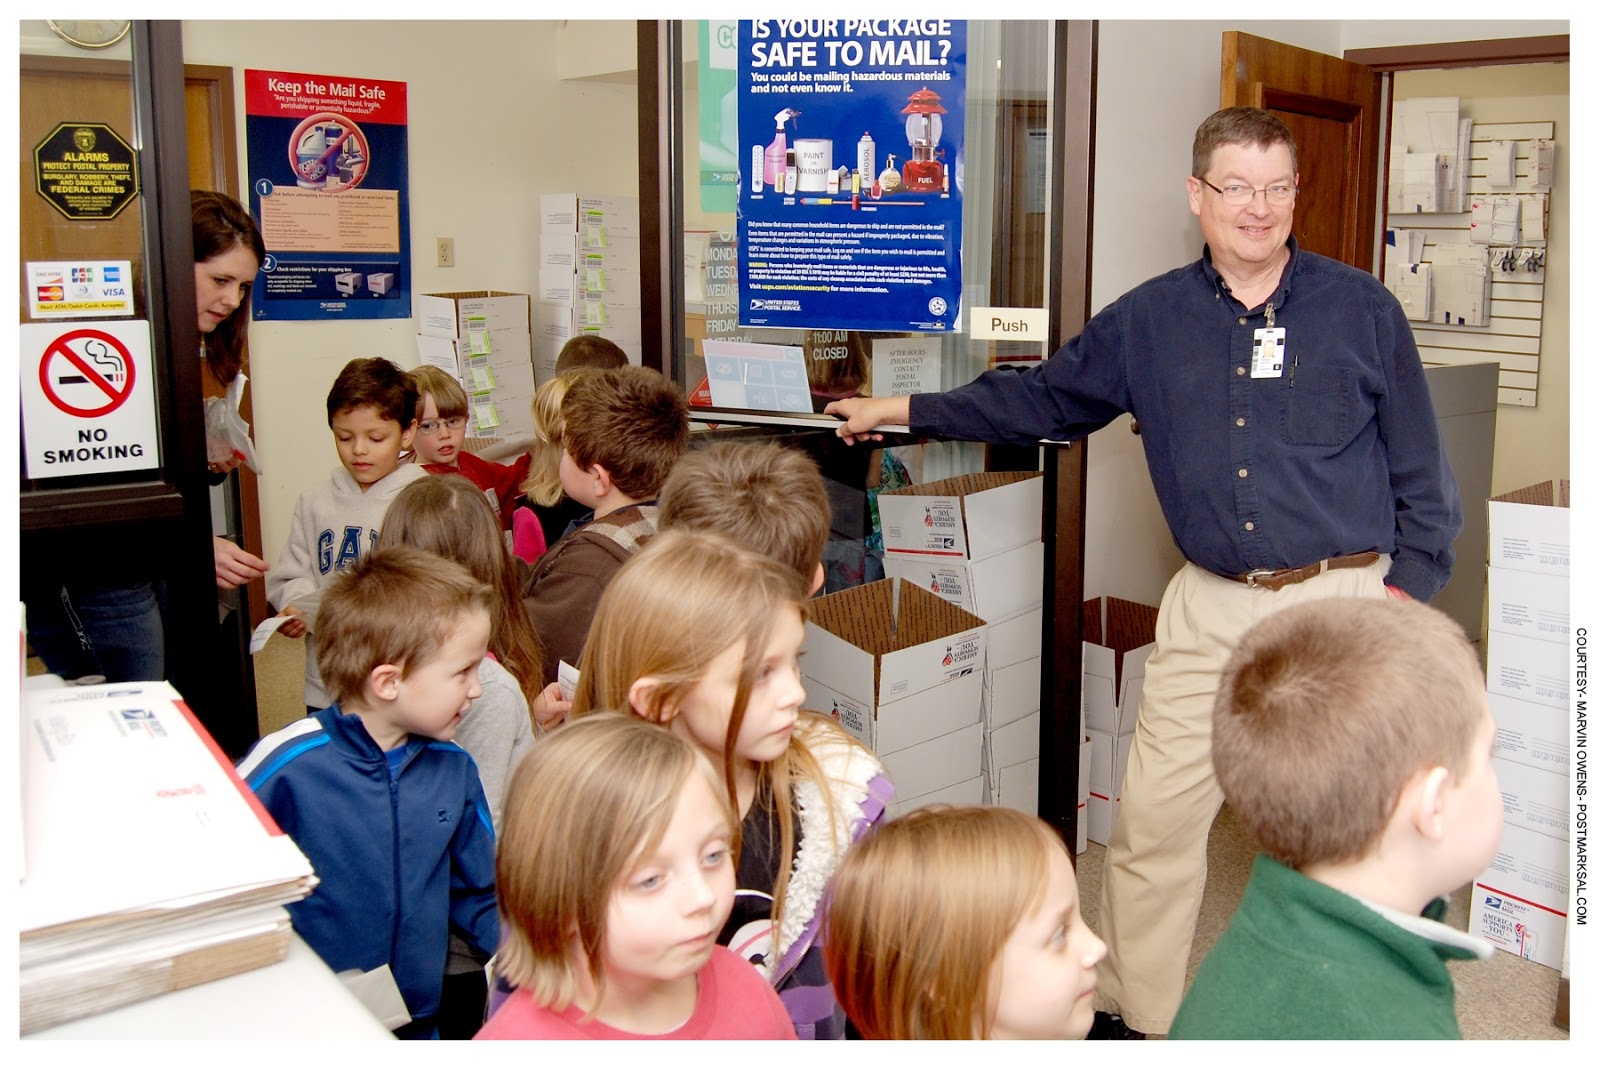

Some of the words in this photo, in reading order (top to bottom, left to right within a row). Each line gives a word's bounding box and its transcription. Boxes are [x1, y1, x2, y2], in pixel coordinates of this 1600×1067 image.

[752, 19, 770, 38] IS
[779, 19, 838, 38] YOUR
[845, 19, 951, 36] PACKAGE
[752, 41, 817, 67] SAFE
[824, 41, 863, 66] TO
[869, 40, 951, 66] MAIL?
[751, 72, 768, 82] You
[771, 72, 796, 82] could
[800, 72, 811, 81] be
[814, 71, 849, 84] mailing
[852, 71, 902, 81] hazardous
[905, 71, 950, 81] materials
[269, 78, 301, 96] Keep
[305, 82, 326, 94] the
[330, 83, 355, 97] Mail
[360, 86, 386, 100] Safe
[751, 83, 769, 93] and
[772, 84, 788, 93] not
[791, 85, 811, 93] even
[815, 82, 841, 92] know
[843, 82, 853, 92] it.
[316, 105, 342, 113] potentially
[64, 153, 109, 162] ALARMS
[262, 182, 267, 193] 1
[264, 258, 271, 269] 2
[706, 266, 738, 279] TUESD
[706, 318, 737, 334] FRIDAY
[991, 317, 1028, 332] Push
[813, 331, 832, 343] 11:00
[835, 330, 848, 342] AM
[813, 347, 848, 360] CLOSED
[78, 428, 108, 443] NO
[44, 444, 143, 464] SMOKING
[1504, 901, 1526, 911] PRIORITY
[1482, 918, 1513, 933] SUPPORTS
[1483, 912, 1513, 927] AMERICA
[1489, 926, 1505, 936] YOU
